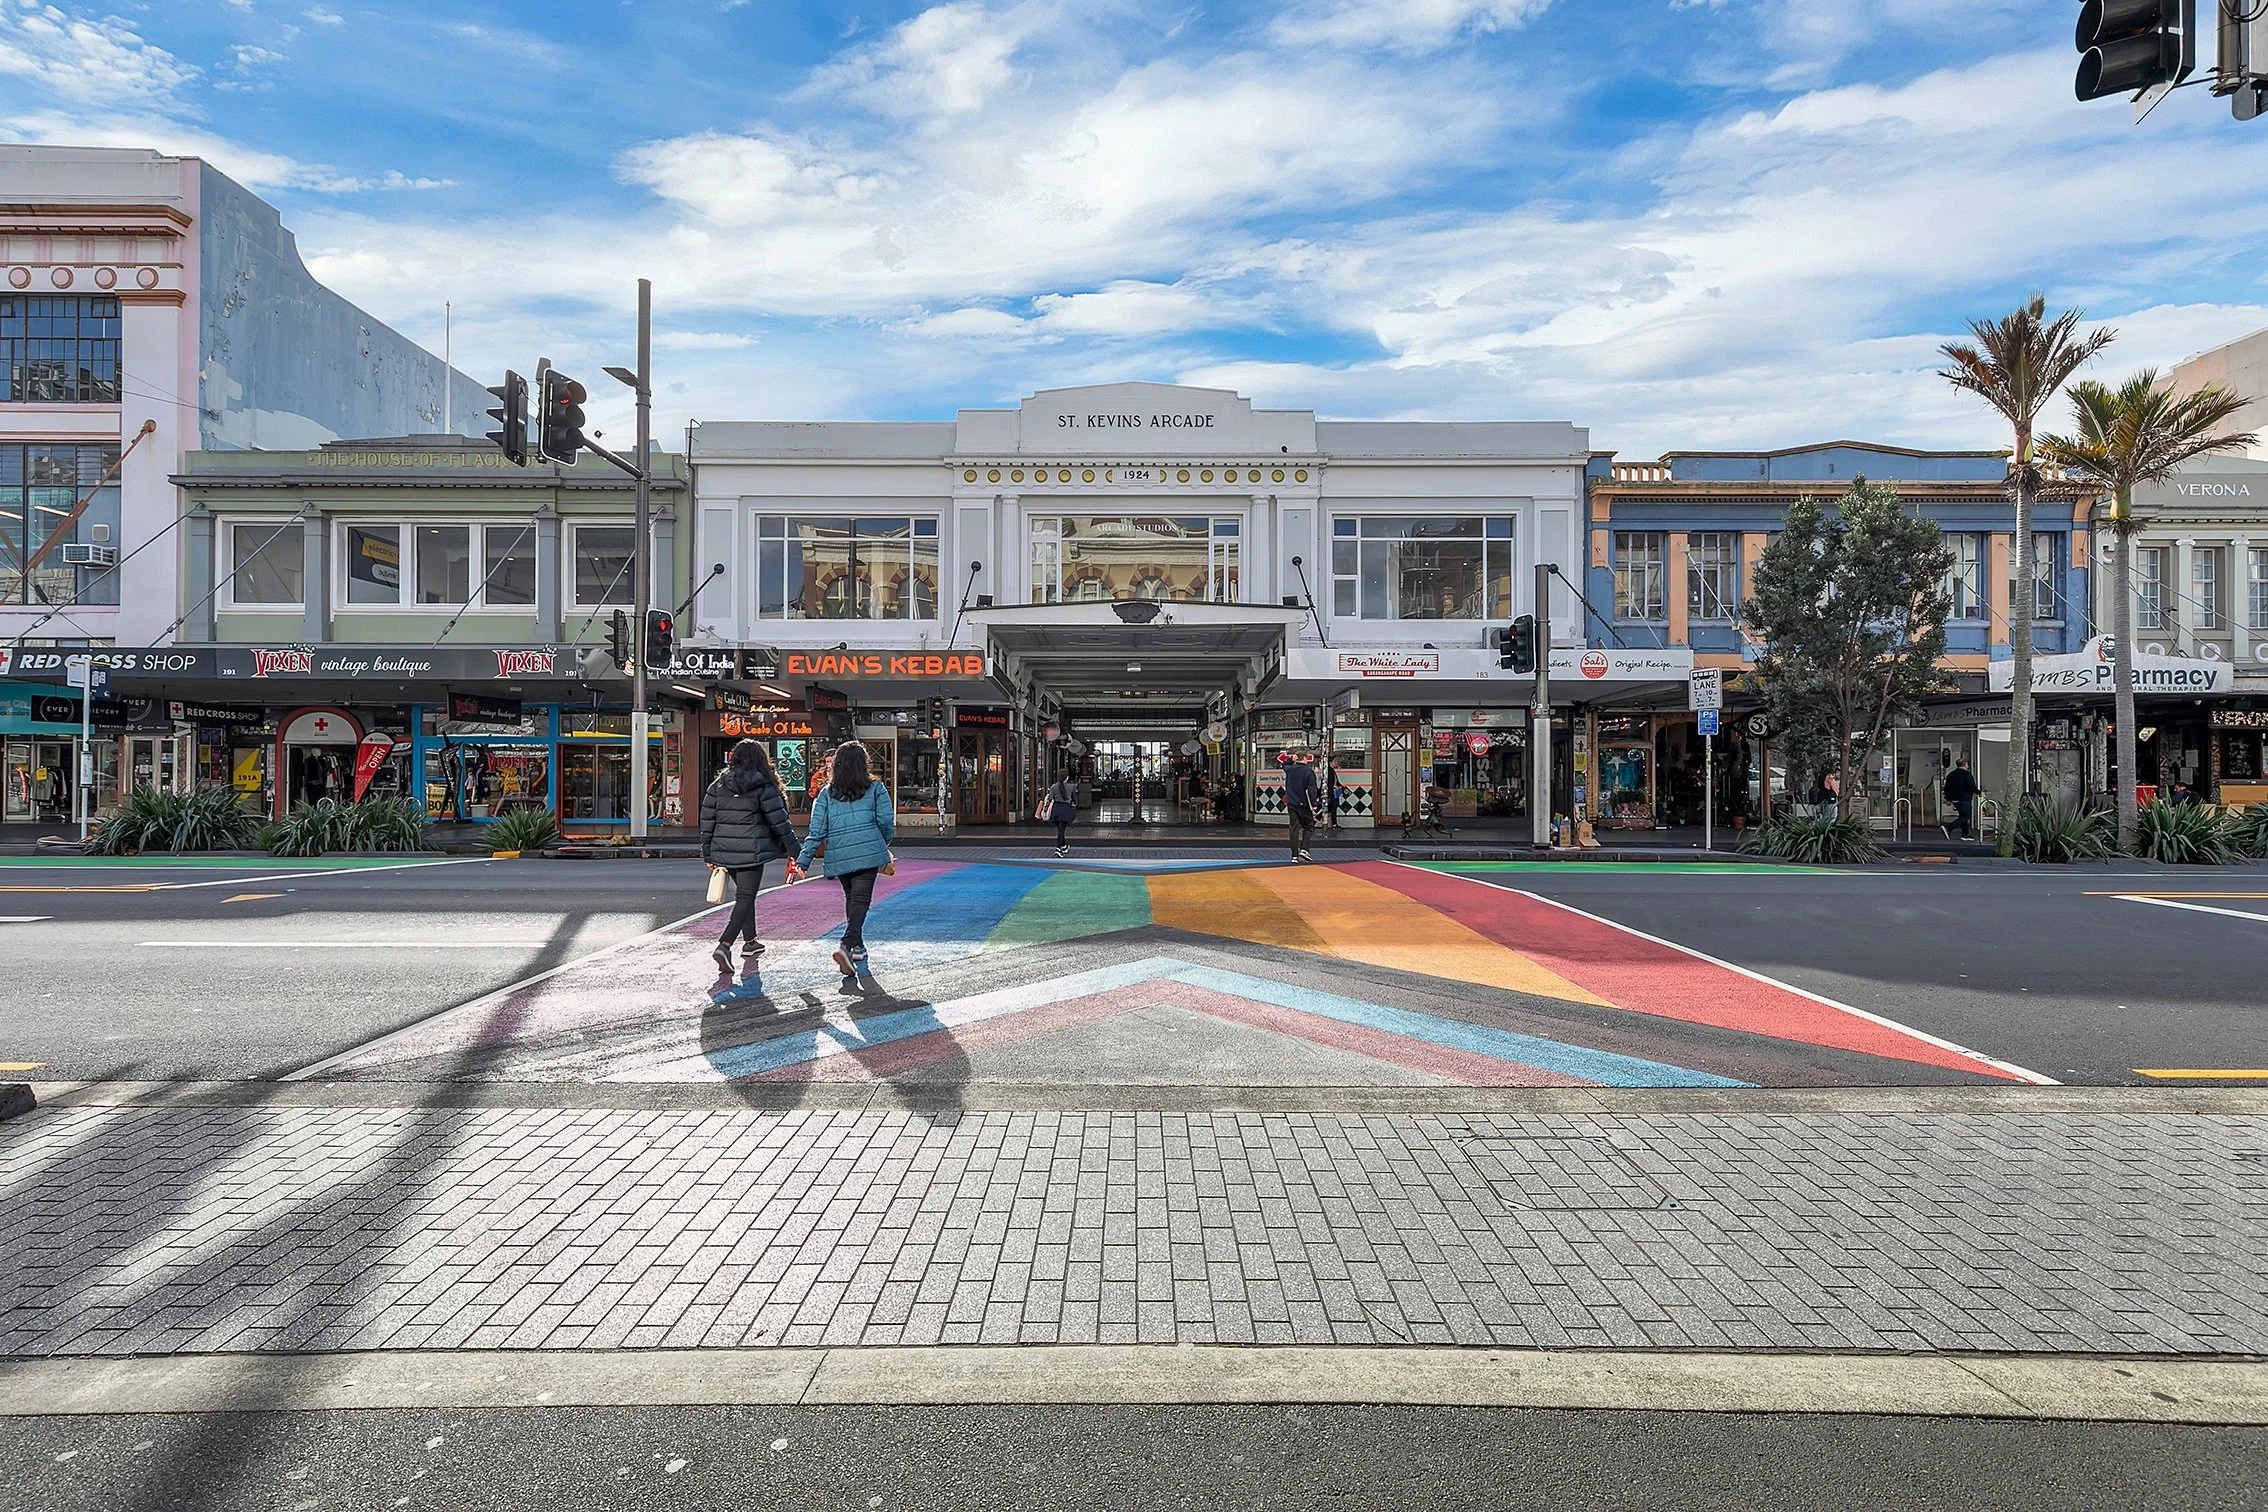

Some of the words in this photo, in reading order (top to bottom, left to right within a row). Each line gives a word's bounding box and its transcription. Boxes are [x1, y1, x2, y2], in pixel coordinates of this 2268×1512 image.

[1058, 415, 1080, 428] ST.
[1087, 415, 1142, 428] KEVINS
[1150, 415, 1215, 428] ARCADE
[315, 452, 349, 467] THE
[355, 452, 413, 467] HOUSE
[419, 452, 441, 467] OF
[1124, 471, 1150, 480] 1924
[2176, 483, 2250, 496] VERONA
[19, 654, 62, 669] RED
[142, 655, 197, 671] SHOP
[250, 649, 315, 678] VIXEN
[321, 656, 369, 676] vintage
[373, 656, 431, 677] boutique
[492, 650, 557, 679] VIXEN
[685, 653, 706, 669] Of
[708, 653, 735, 669] India
[788, 655, 883, 675] EVAN'S
[891, 655, 983, 675] KEBAB
[1346, 657, 1368, 667] The
[1368, 657, 1399, 667] White
[1401, 657, 1431, 669] Lady
[1583, 655, 1605, 666] Sal's
[1615, 659, 1643, 673] Original
[1645, 659, 1673, 672] Recipe.
[222, 668, 236, 676] 191
[1694, 681, 1717, 690] LANE
[46, 705, 69, 713] EVER
[187, 707, 205, 717] RED
[206, 709, 237, 719] CROSS
[238, 712, 259, 721] SHOP
[1703, 711, 1713, 719] P5
[1966, 706, 2013, 717] Pharmac
[959, 714, 983, 723] EVAN'S
[983, 716, 1007, 724] KEBAB
[773, 721, 789, 735] Of
[369, 747, 386, 769] OPEN
